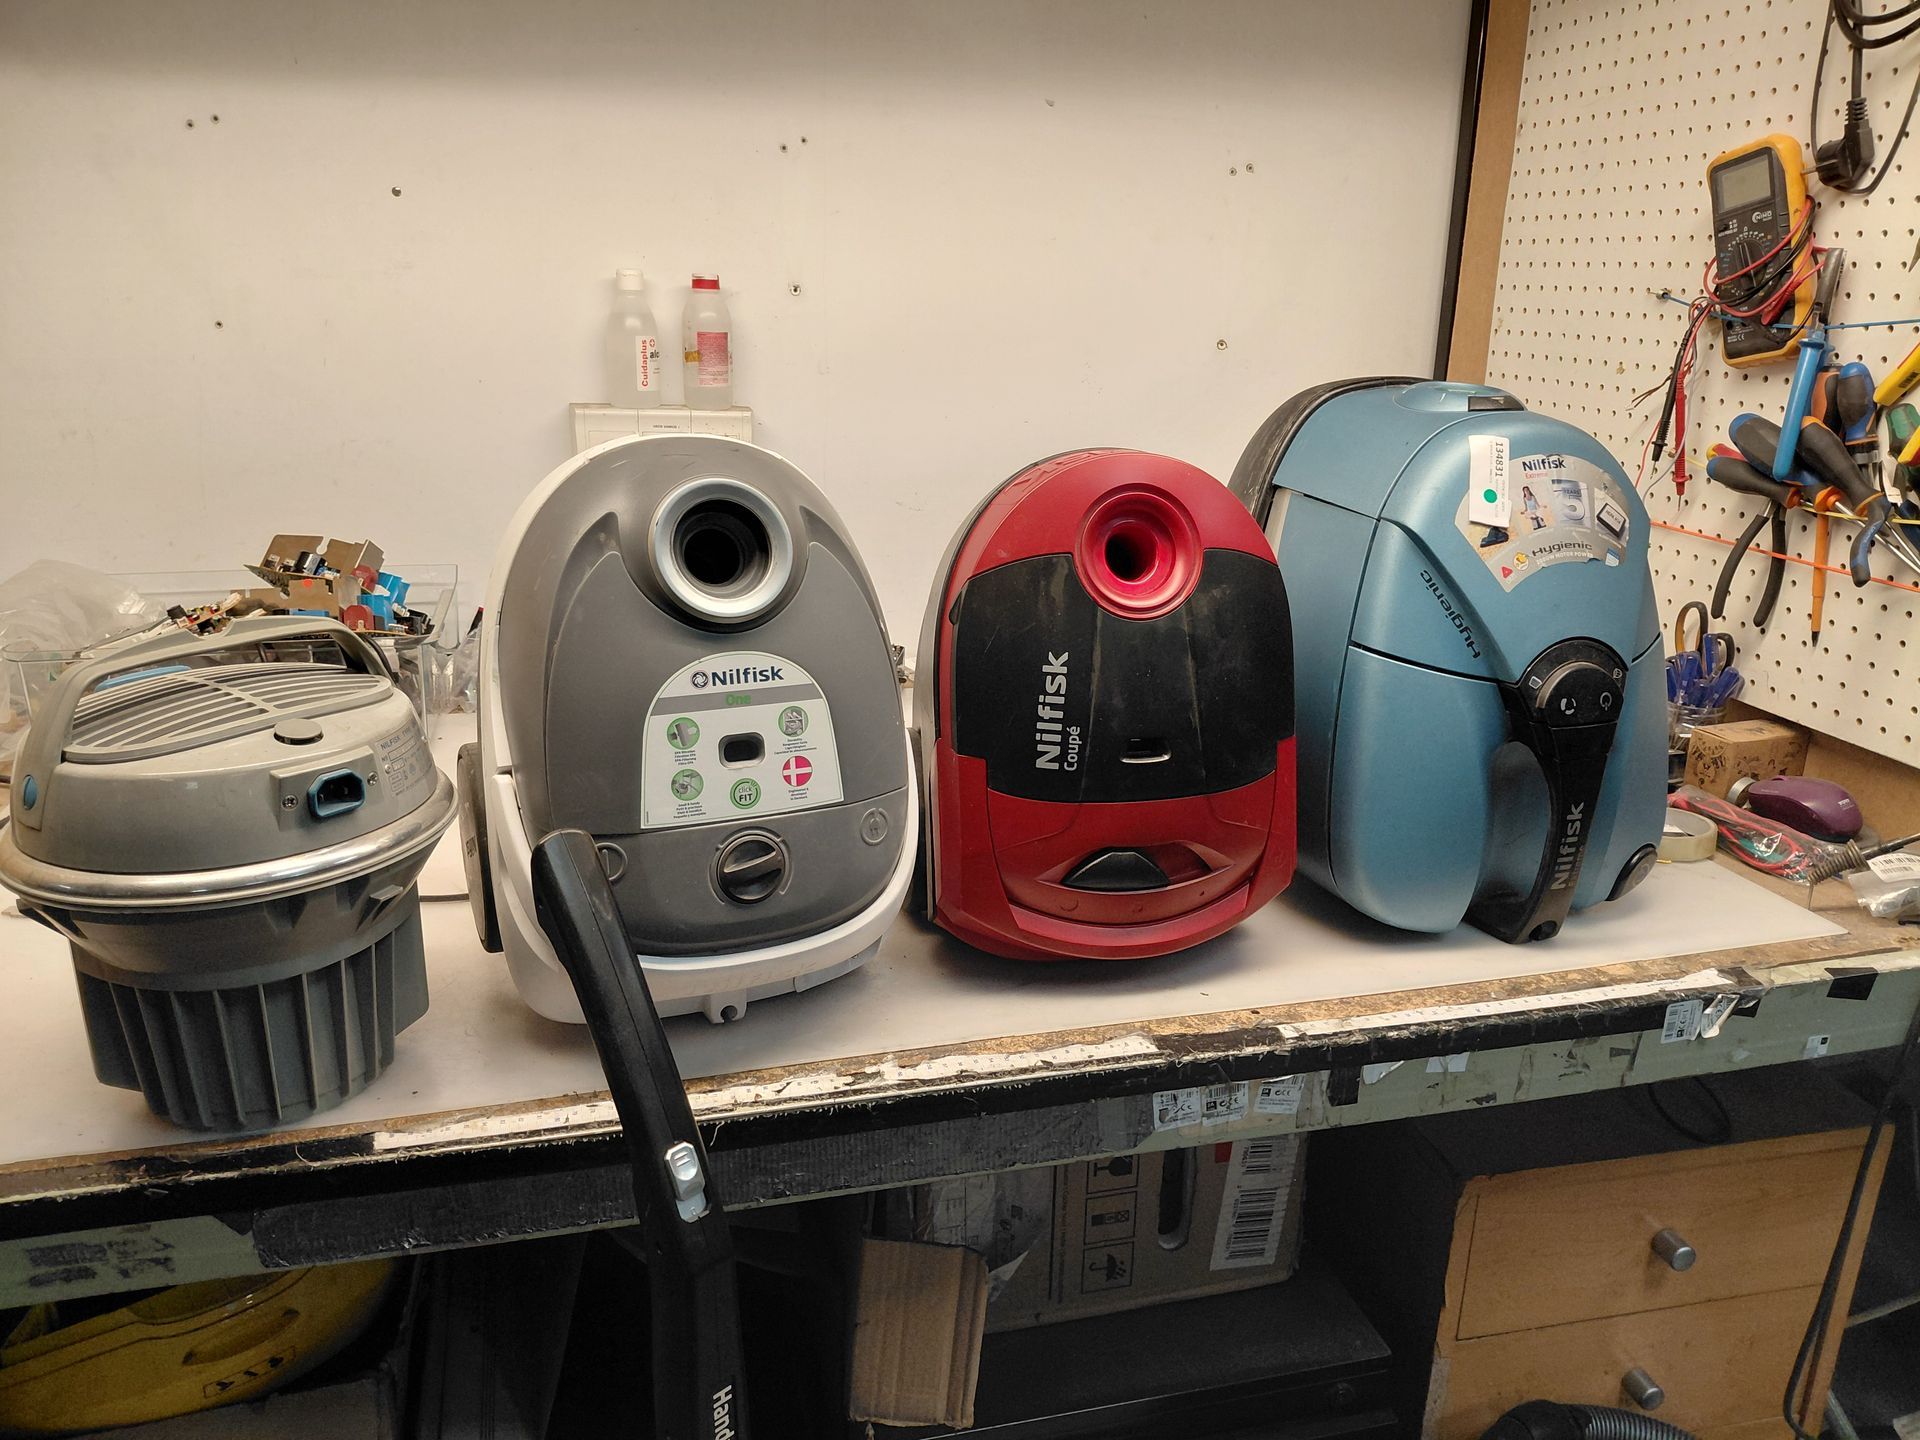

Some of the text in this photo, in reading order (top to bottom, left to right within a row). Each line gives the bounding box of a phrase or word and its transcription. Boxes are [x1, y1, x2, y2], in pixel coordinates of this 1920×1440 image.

[641, 339, 649, 387] Cuidaplus
[1495, 442, 1504, 477] 134831
[1522, 458, 1566, 471] Nilfisk
[1532, 541, 1593, 556] Hygienic
[1420, 570, 1481, 659] Hygienic
[711, 666, 784, 686] Nilfisk
[726, 694, 752, 706] One
[1035, 651, 1069, 770] Nilfisk
[1063, 726, 1082, 771] Coupé
[739, 793, 753, 803] FIT
[1550, 802, 1584, 890] Nilfisk
[712, 1384, 735, 1440] Hand
